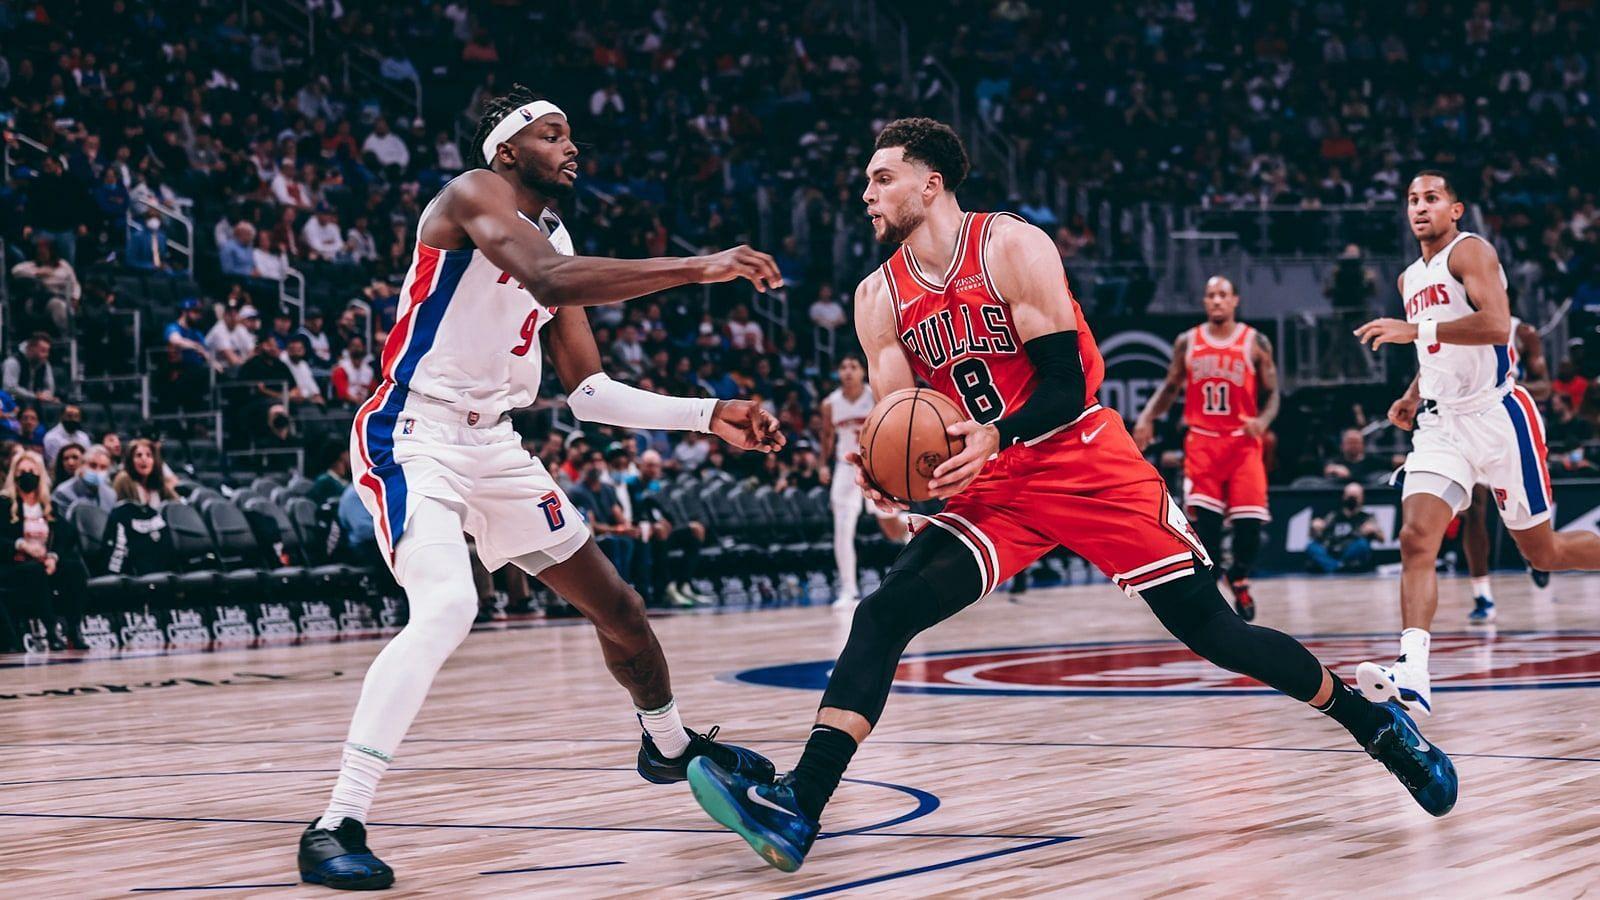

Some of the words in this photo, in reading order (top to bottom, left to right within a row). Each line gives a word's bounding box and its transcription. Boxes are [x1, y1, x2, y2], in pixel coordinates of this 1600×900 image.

[954, 273, 983, 288] ZENN
[510, 309, 538, 357] 9
[950, 357, 1006, 427] 8
[1202, 381, 1231, 416] 11
